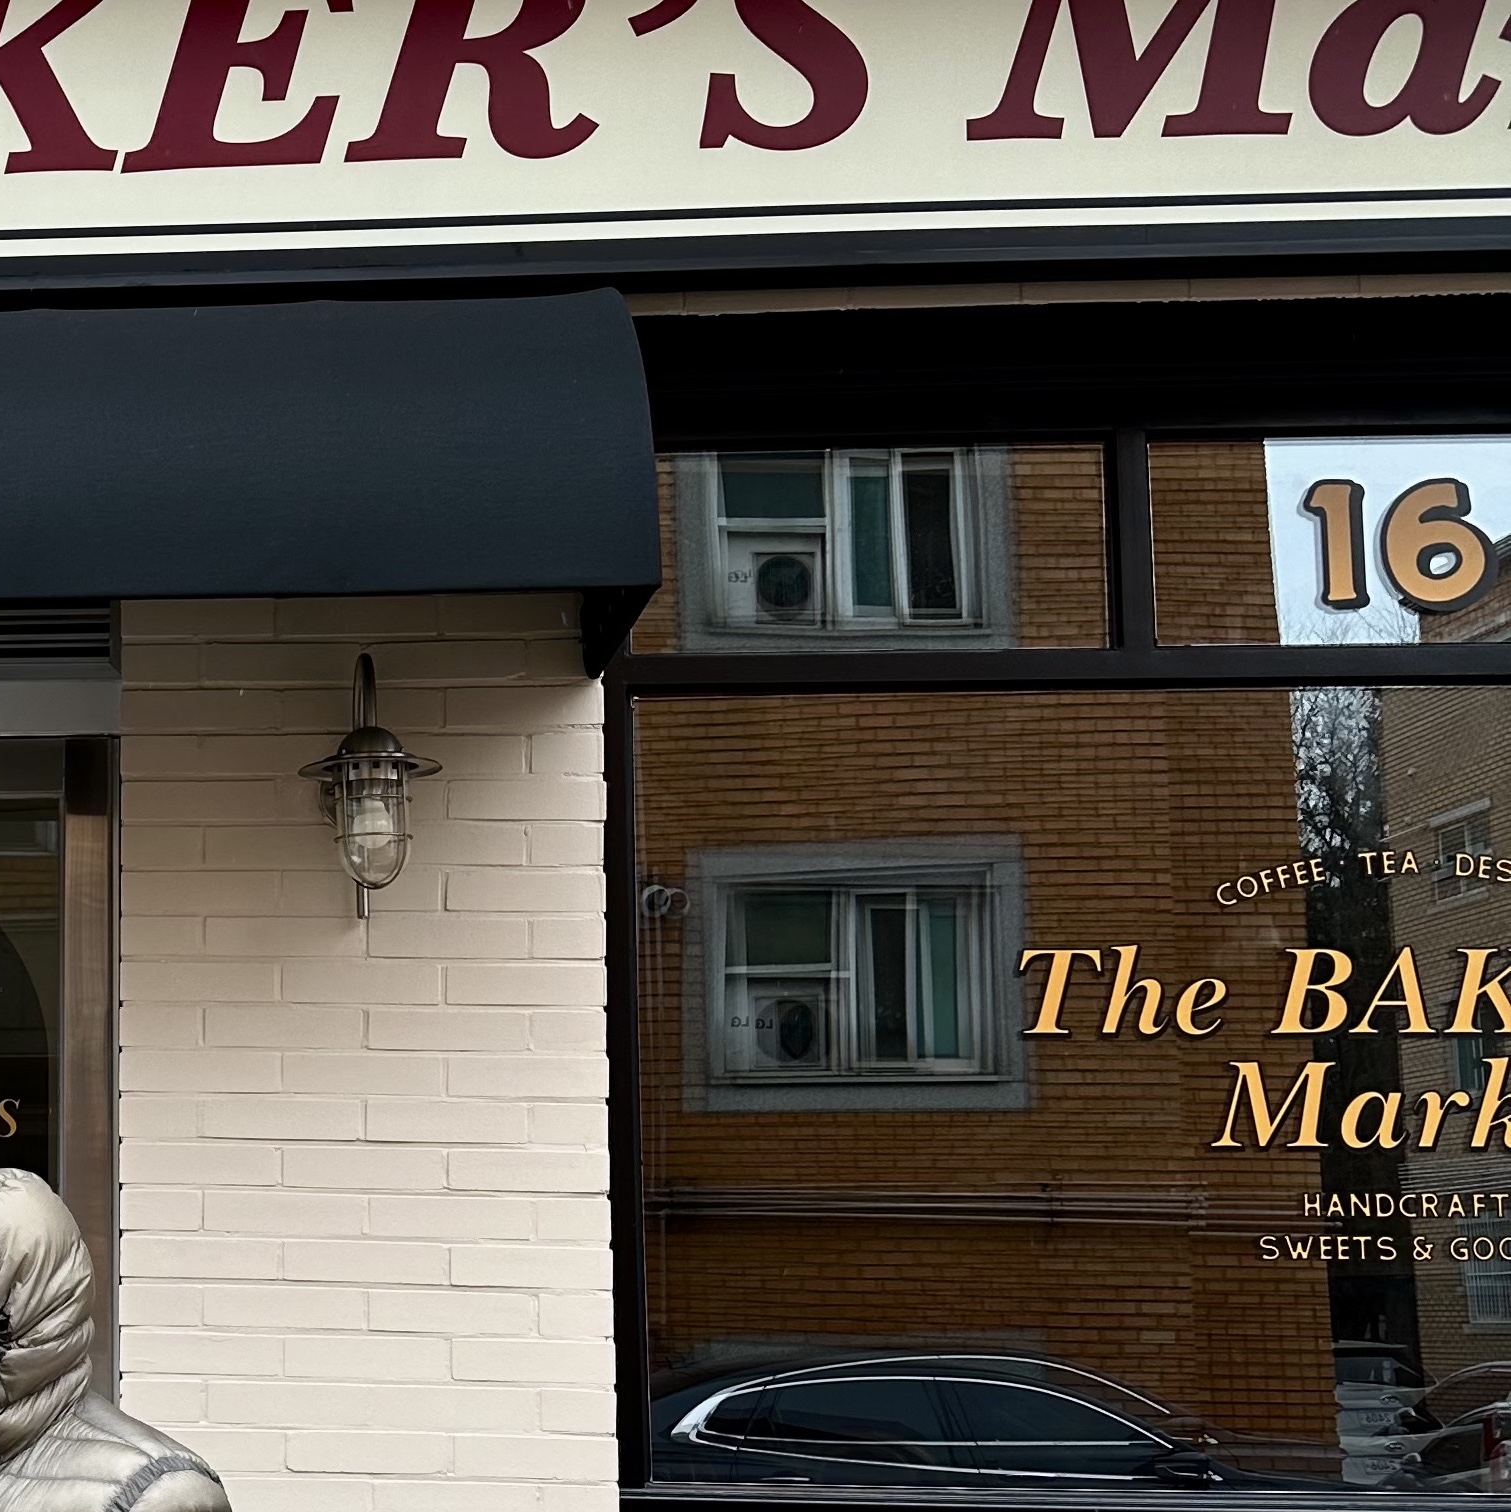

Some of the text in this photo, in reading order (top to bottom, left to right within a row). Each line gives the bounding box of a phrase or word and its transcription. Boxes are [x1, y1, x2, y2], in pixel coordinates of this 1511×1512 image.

[966, 0, 1511, 141] Ma
[1303, 478, 1497, 615] 16
[1216, 857, 1326, 906] COFFEE
[1358, 851, 1420, 876] TEA
[1019, 944, 1511, 1036] The BAK
[1211, 1056, 1511, 1149] Mark
[1259, 1235, 1398, 1261] SWEETS
[1412, 1236, 1434, 1261] &
[1304, 1192, 1510, 1218] HANDCRAFT
